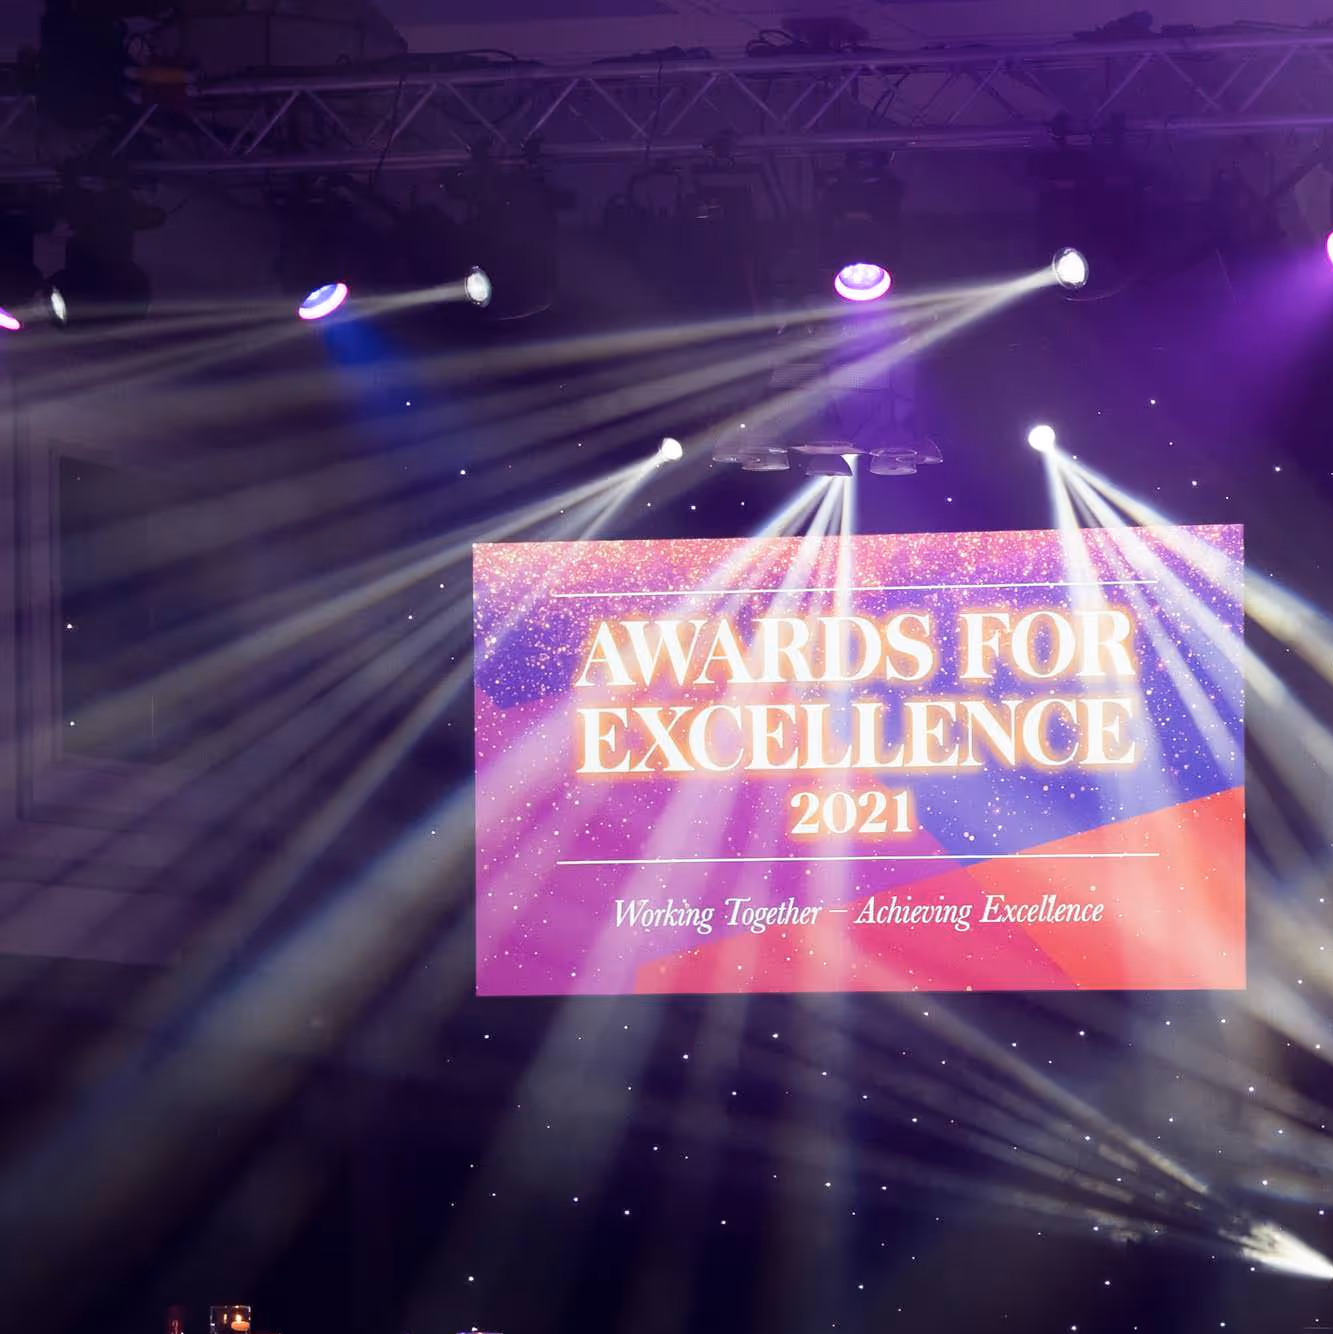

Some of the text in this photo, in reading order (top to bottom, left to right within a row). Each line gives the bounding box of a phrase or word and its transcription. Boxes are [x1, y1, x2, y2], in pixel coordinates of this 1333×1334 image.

[575, 609, 1136, 688] AWARDS FOR
[577, 697, 1136, 774] EXCELLENCE
[790, 790, 913, 834] 2021
[614, 898, 714, 934] Working
[724, 896, 823, 934] Together
[854, 895, 973, 931] Achieving
[978, 893, 1104, 924] Excellence
